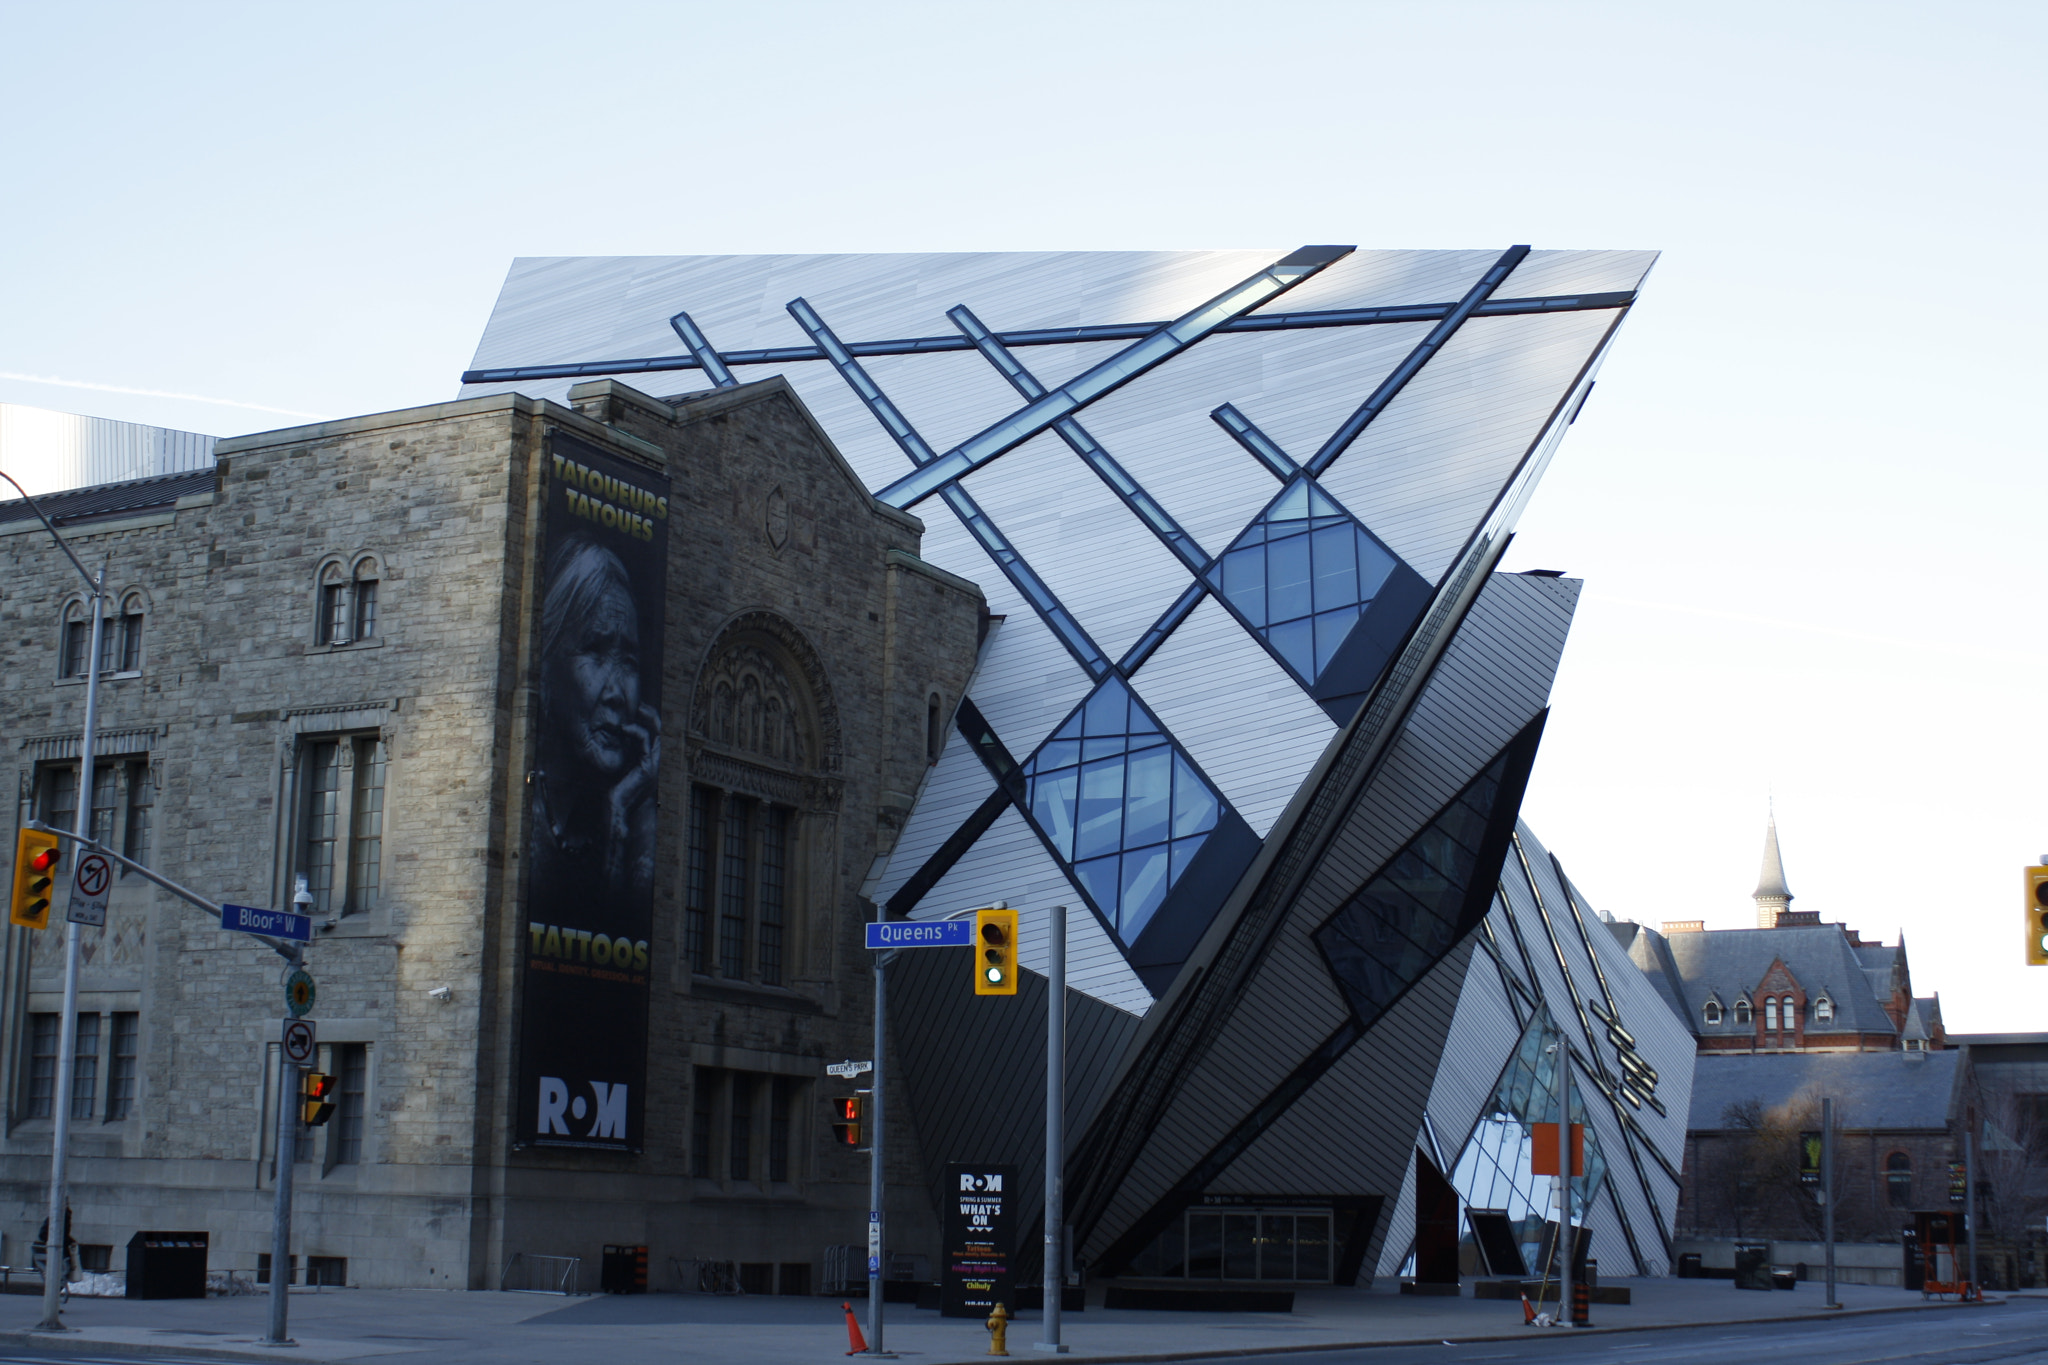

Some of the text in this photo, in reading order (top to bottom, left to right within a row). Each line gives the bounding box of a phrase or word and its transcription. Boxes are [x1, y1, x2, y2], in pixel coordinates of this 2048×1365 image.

[552, 452, 668, 520] TATOUEURS
[565, 487, 654, 542] TATOUÉS
[239, 908, 296, 934] Bloor St W
[880, 922, 958, 943] Queens Pk
[529, 921, 649, 971] TATTOOS
[829, 1062, 869, 1074] QUEEN'S PARK
[537, 1076, 628, 1140] ROM
[960, 1173, 1003, 1192] ROM
[960, 1204, 1001, 1216] WHAT'S
[972, 1214, 988, 1226] ON
[966, 1282, 992, 1291] Chihuly
